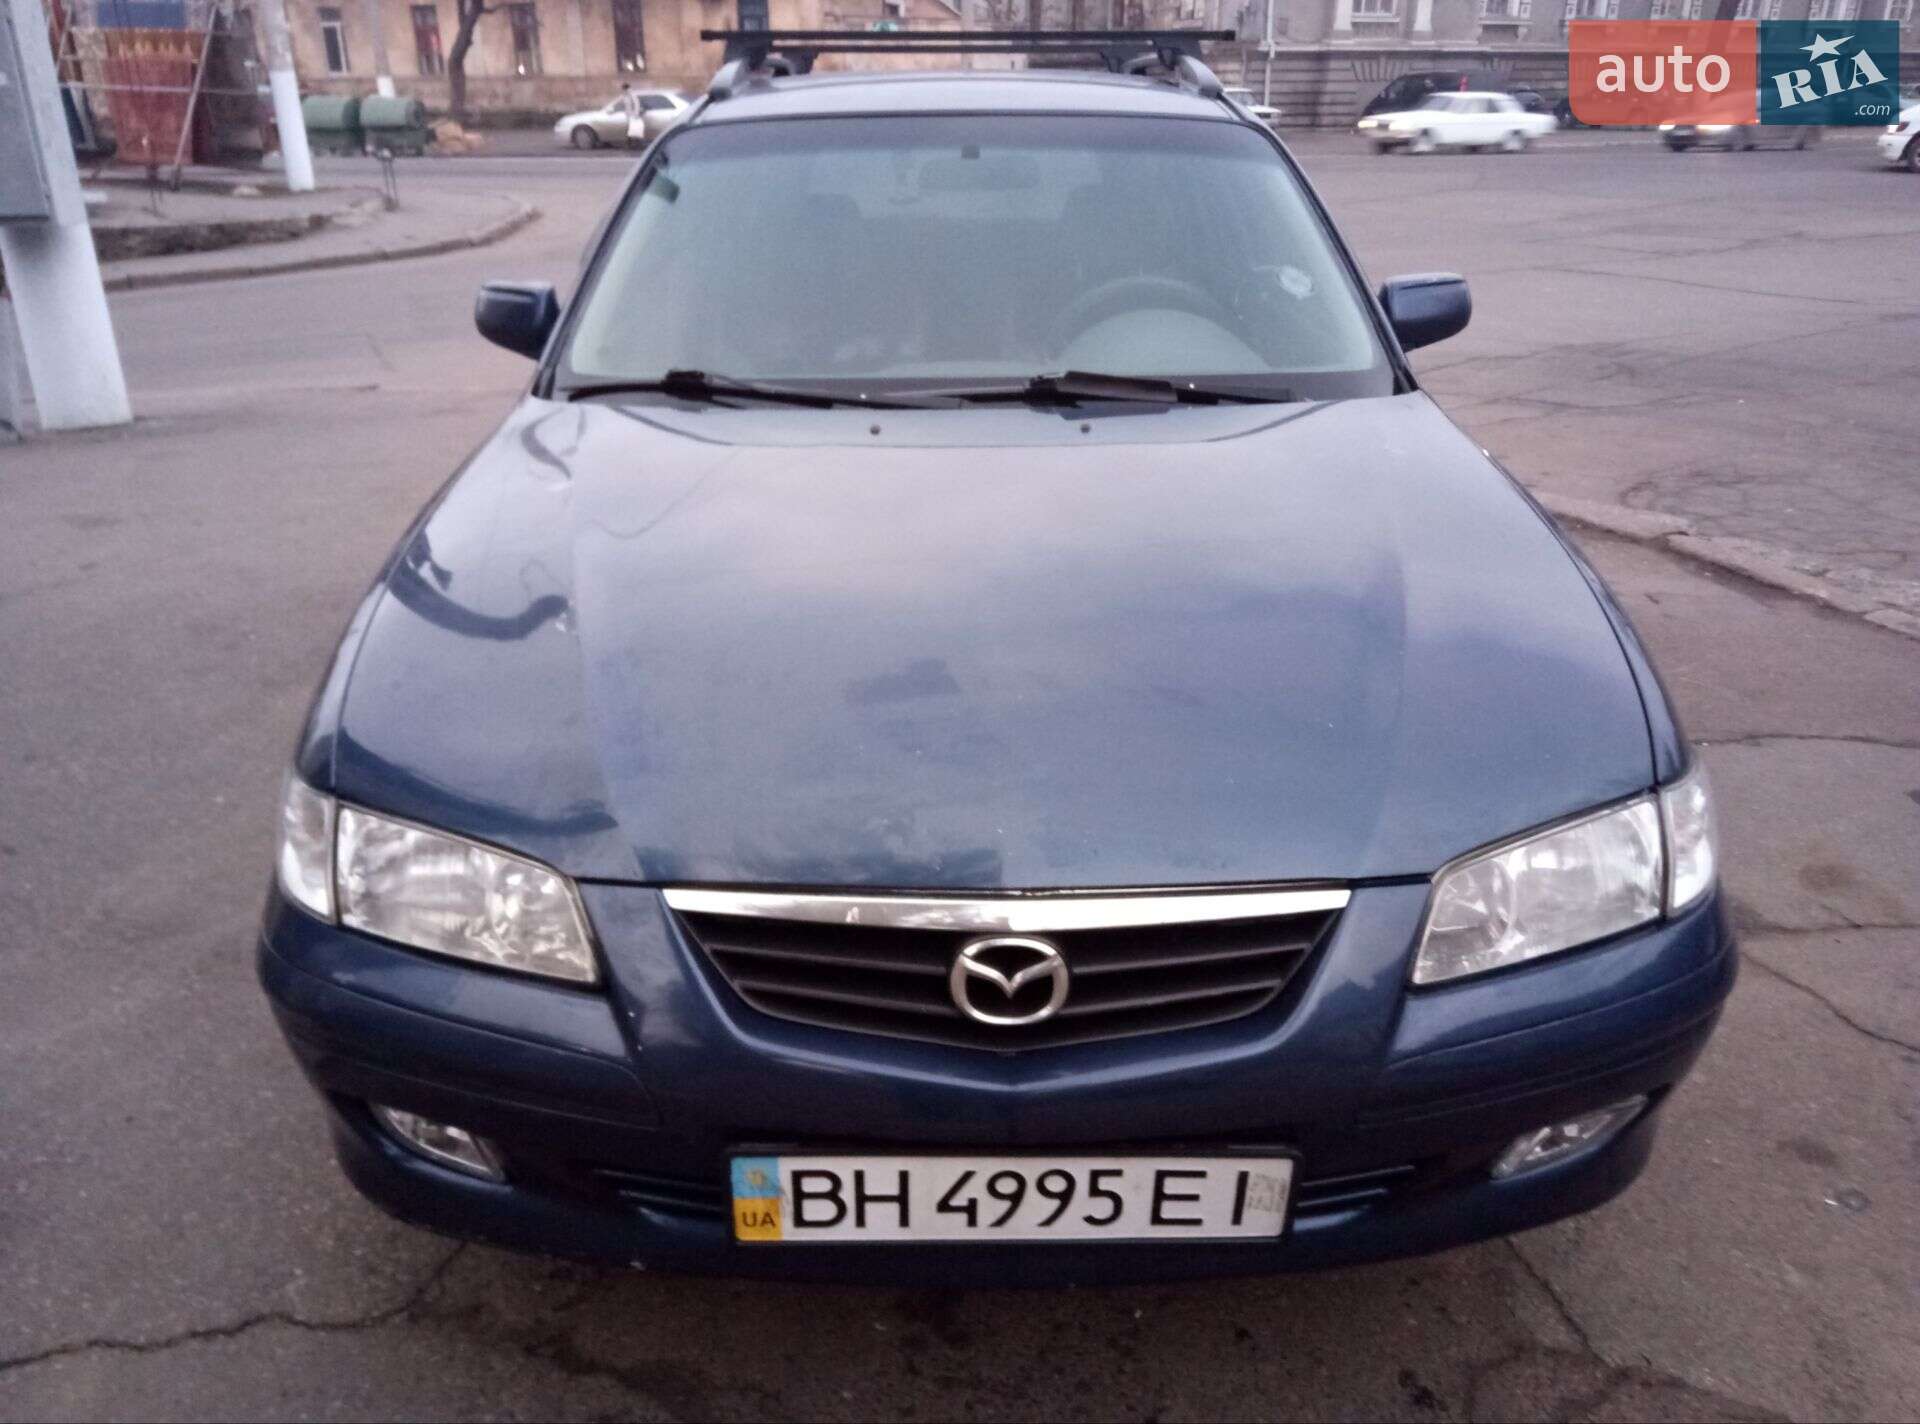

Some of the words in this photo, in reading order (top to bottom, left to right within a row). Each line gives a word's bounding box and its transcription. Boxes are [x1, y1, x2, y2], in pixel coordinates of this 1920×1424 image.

[790, 1169, 910, 1229] BH
[936, 1168, 1124, 1228] 4995
[742, 1211, 777, 1230] UA
